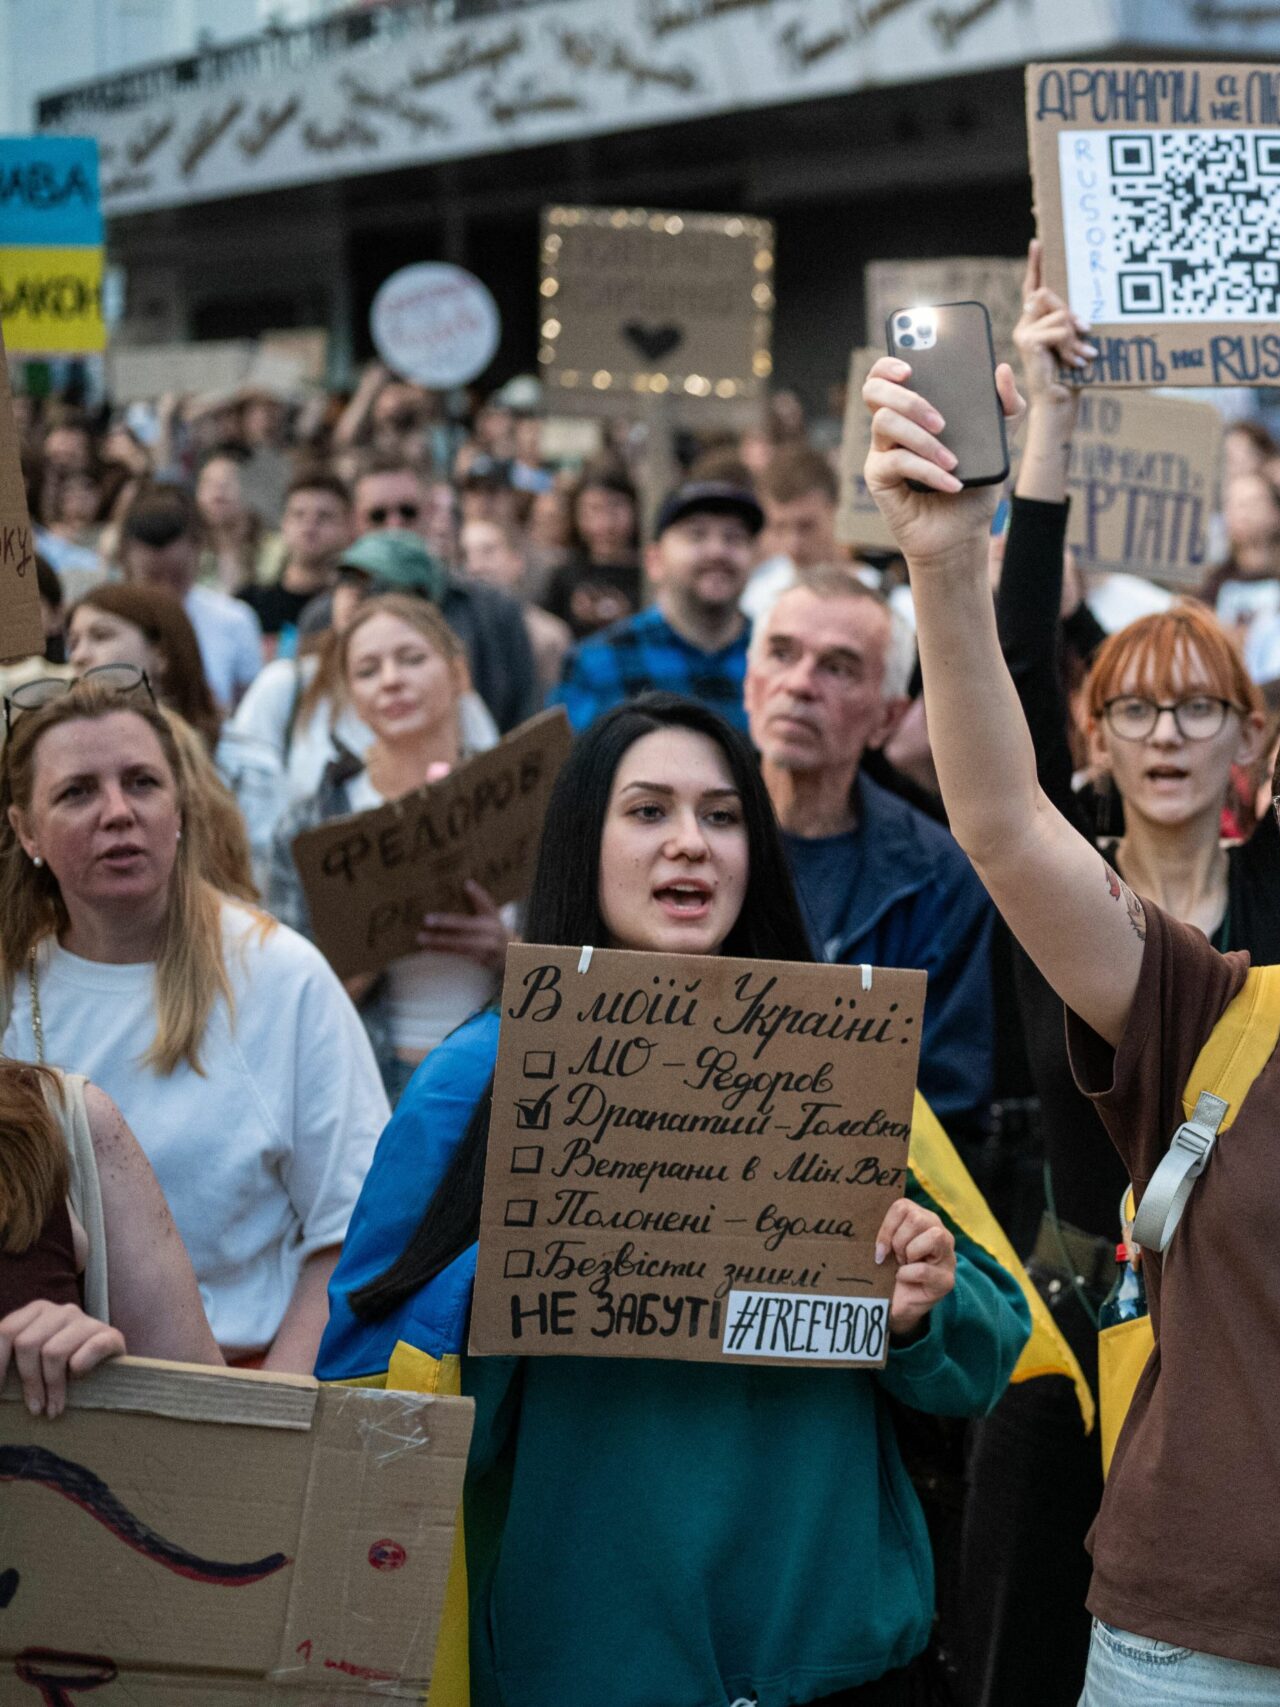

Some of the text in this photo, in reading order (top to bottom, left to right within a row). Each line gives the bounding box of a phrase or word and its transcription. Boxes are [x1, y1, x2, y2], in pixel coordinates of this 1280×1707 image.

[1036, 69, 1201, 123] ДРОНАМИ
[1059, 335, 1167, 384] ОНАТЬ
[508, 965, 915, 1060] В моїй Україні:
[568, 1036, 657, 1078] МО
[683, 1046, 833, 1115] Федоров
[551, 1137, 730, 1194] Ветерани
[742, 1155, 761, 1182] в
[546, 1188, 717, 1237] Полонені
[755, 1199, 856, 1252] вдома
[536, 1240, 707, 1296] Безвісти
[714, 1262, 828, 1300] зниклі
[510, 1292, 579, 1339] НЕ
[728, 1295, 887, 1358] #FREE4308
